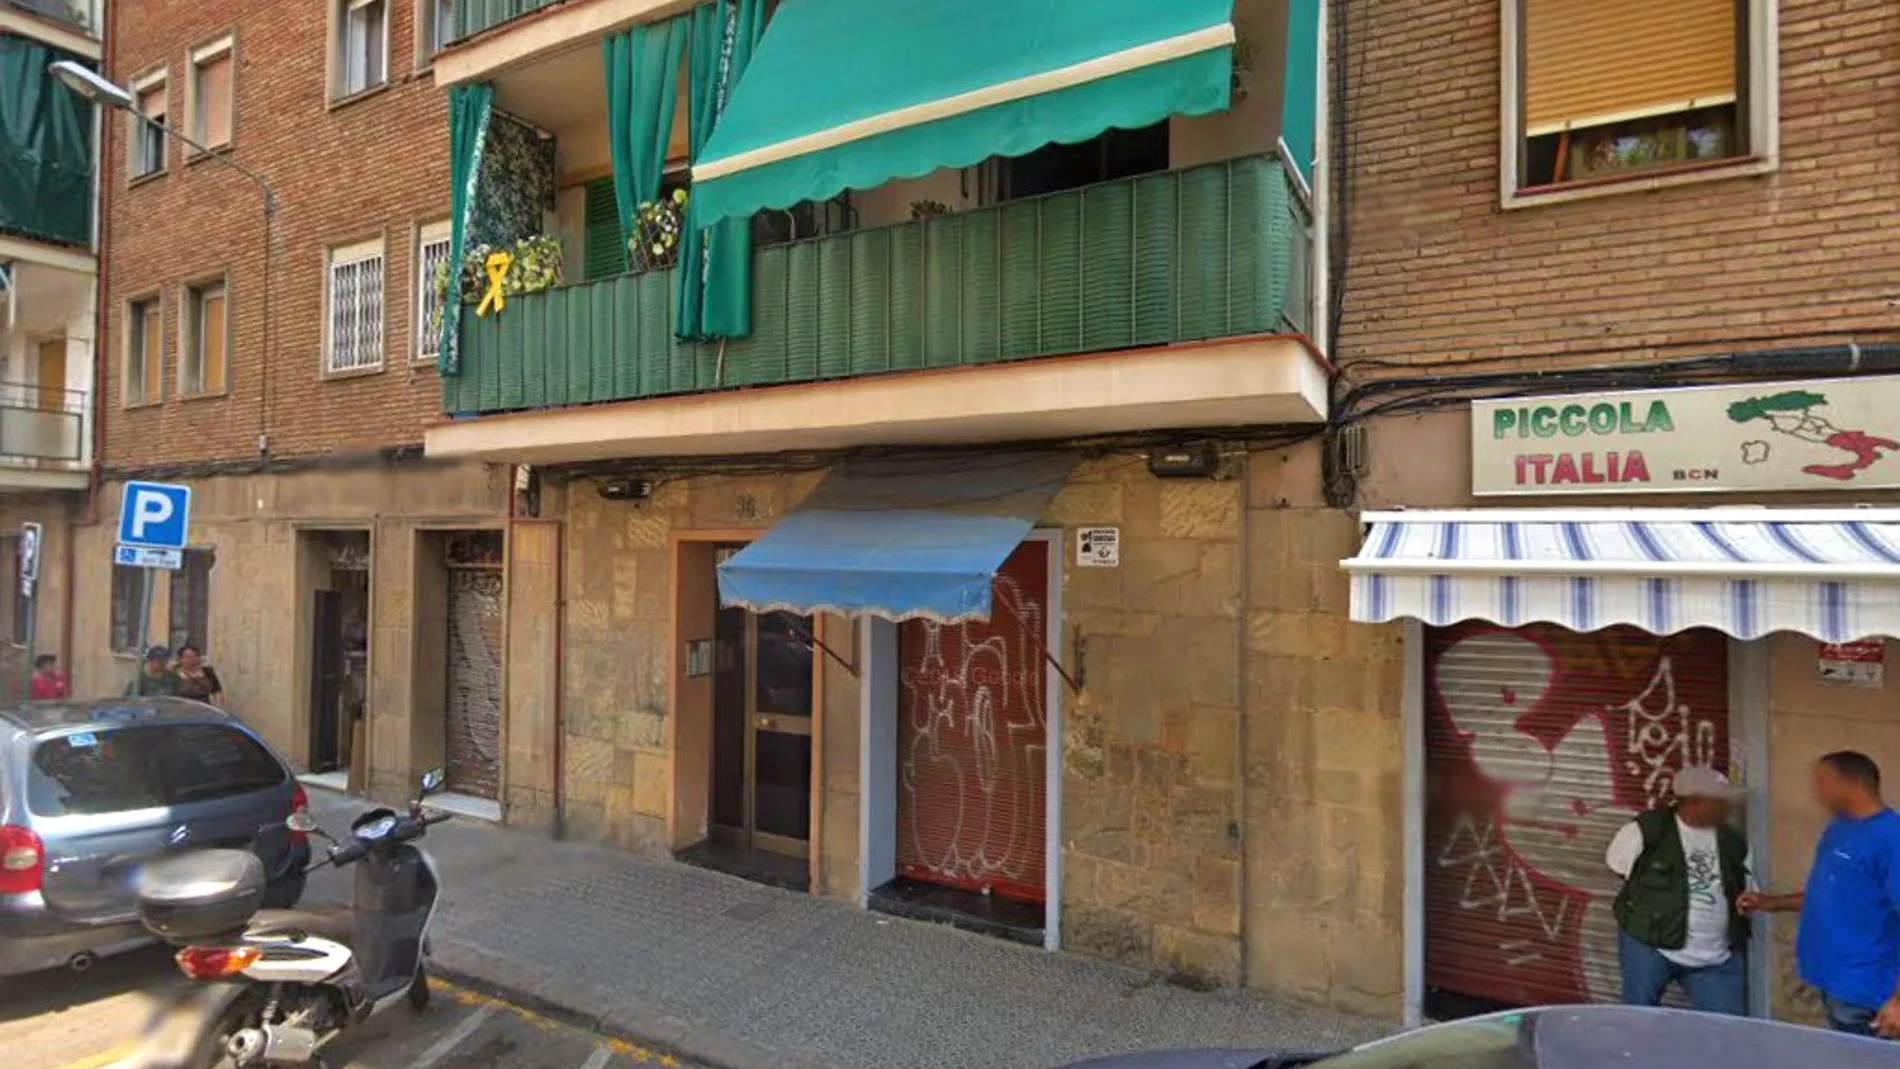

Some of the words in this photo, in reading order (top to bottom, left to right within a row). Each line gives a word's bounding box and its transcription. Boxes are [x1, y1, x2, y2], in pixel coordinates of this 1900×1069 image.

[1493, 400, 1675, 439] PICCOLA
[1515, 450, 1651, 485] ITALIA
[1672, 469, 1719, 481] BCN
[132, 489, 174, 538] P
